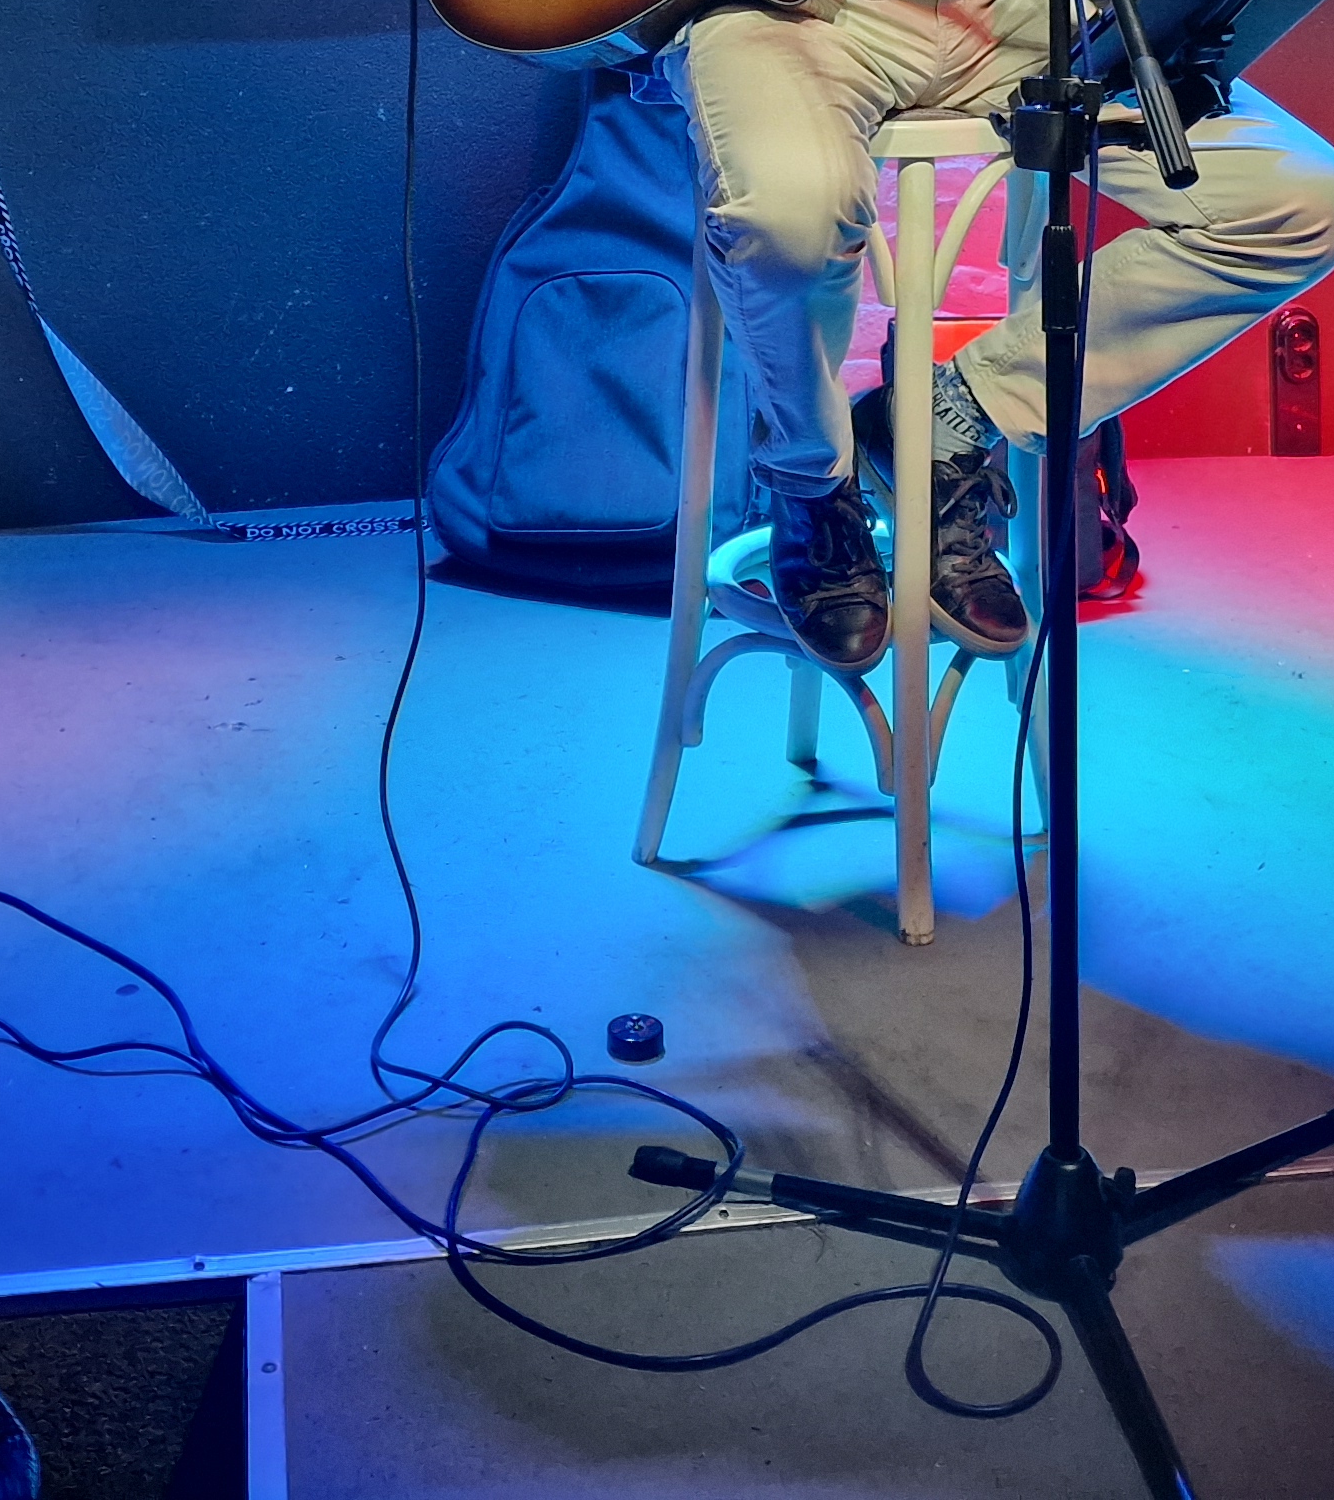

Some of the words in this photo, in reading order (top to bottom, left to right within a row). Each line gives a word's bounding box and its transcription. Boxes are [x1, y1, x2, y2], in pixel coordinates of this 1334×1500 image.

[246, 527, 274, 538] DO
[282, 524, 322, 536] NOT
[332, 521, 399, 533] CROSS
